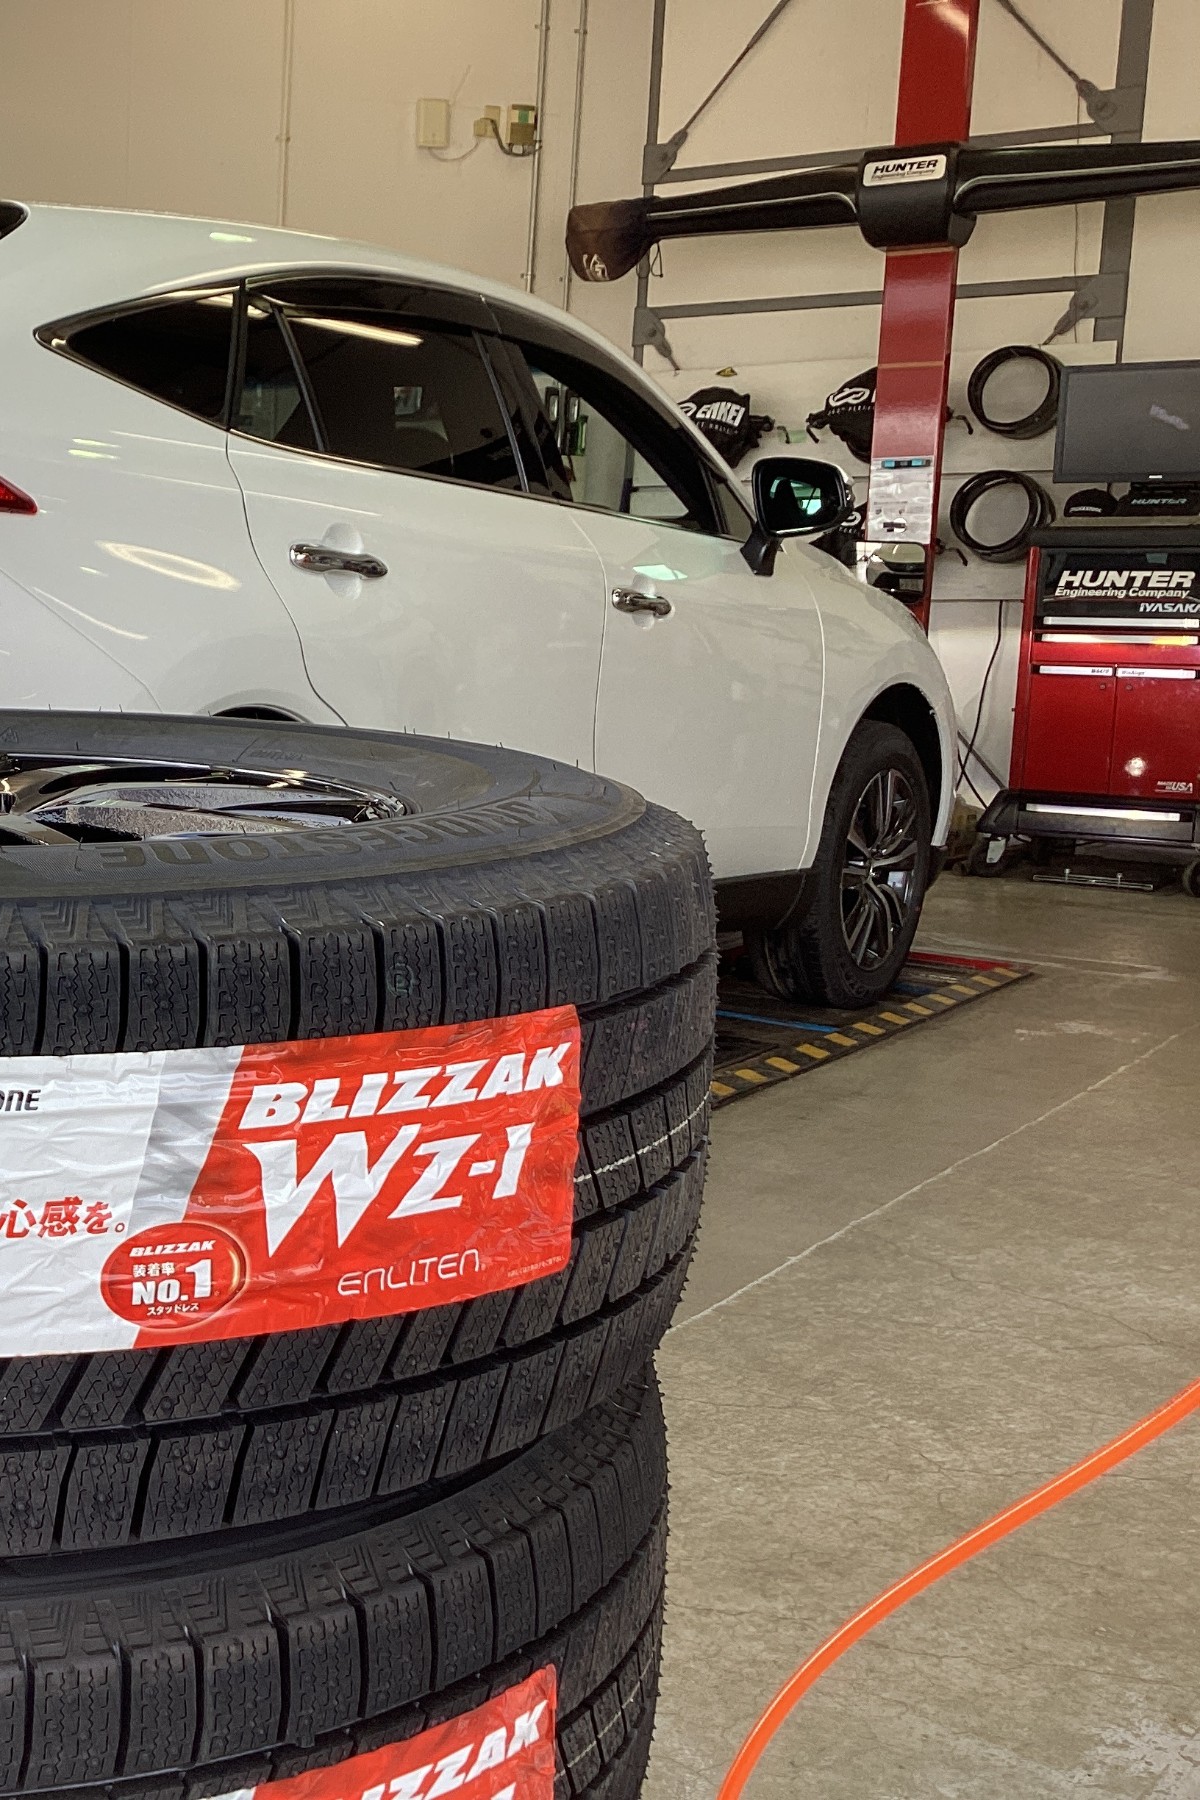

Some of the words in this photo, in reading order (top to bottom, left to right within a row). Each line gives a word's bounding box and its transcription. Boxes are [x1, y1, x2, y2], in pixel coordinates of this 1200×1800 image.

[874, 159, 938, 174] HUNTER
[696, 402, 745, 427] ENKEI
[1058, 570, 1196, 587] HUNTER
[1055, 586, 1126, 598] Engineering
[1129, 587, 1190, 599] Company
[100, 800, 568, 868] BRIDGESTONE
[239, 1041, 570, 1130] BLIZZAK
[241, 1122, 532, 1259] WZ-1
[129, 1240, 216, 1257] BLIZZAK
[132, 1262, 176, 1278] 装着率
[337, 1249, 480, 1296] ENLITEN
[132, 1259, 212, 1305] NO.1
[147, 1303, 199, 1316] スタッドレス
